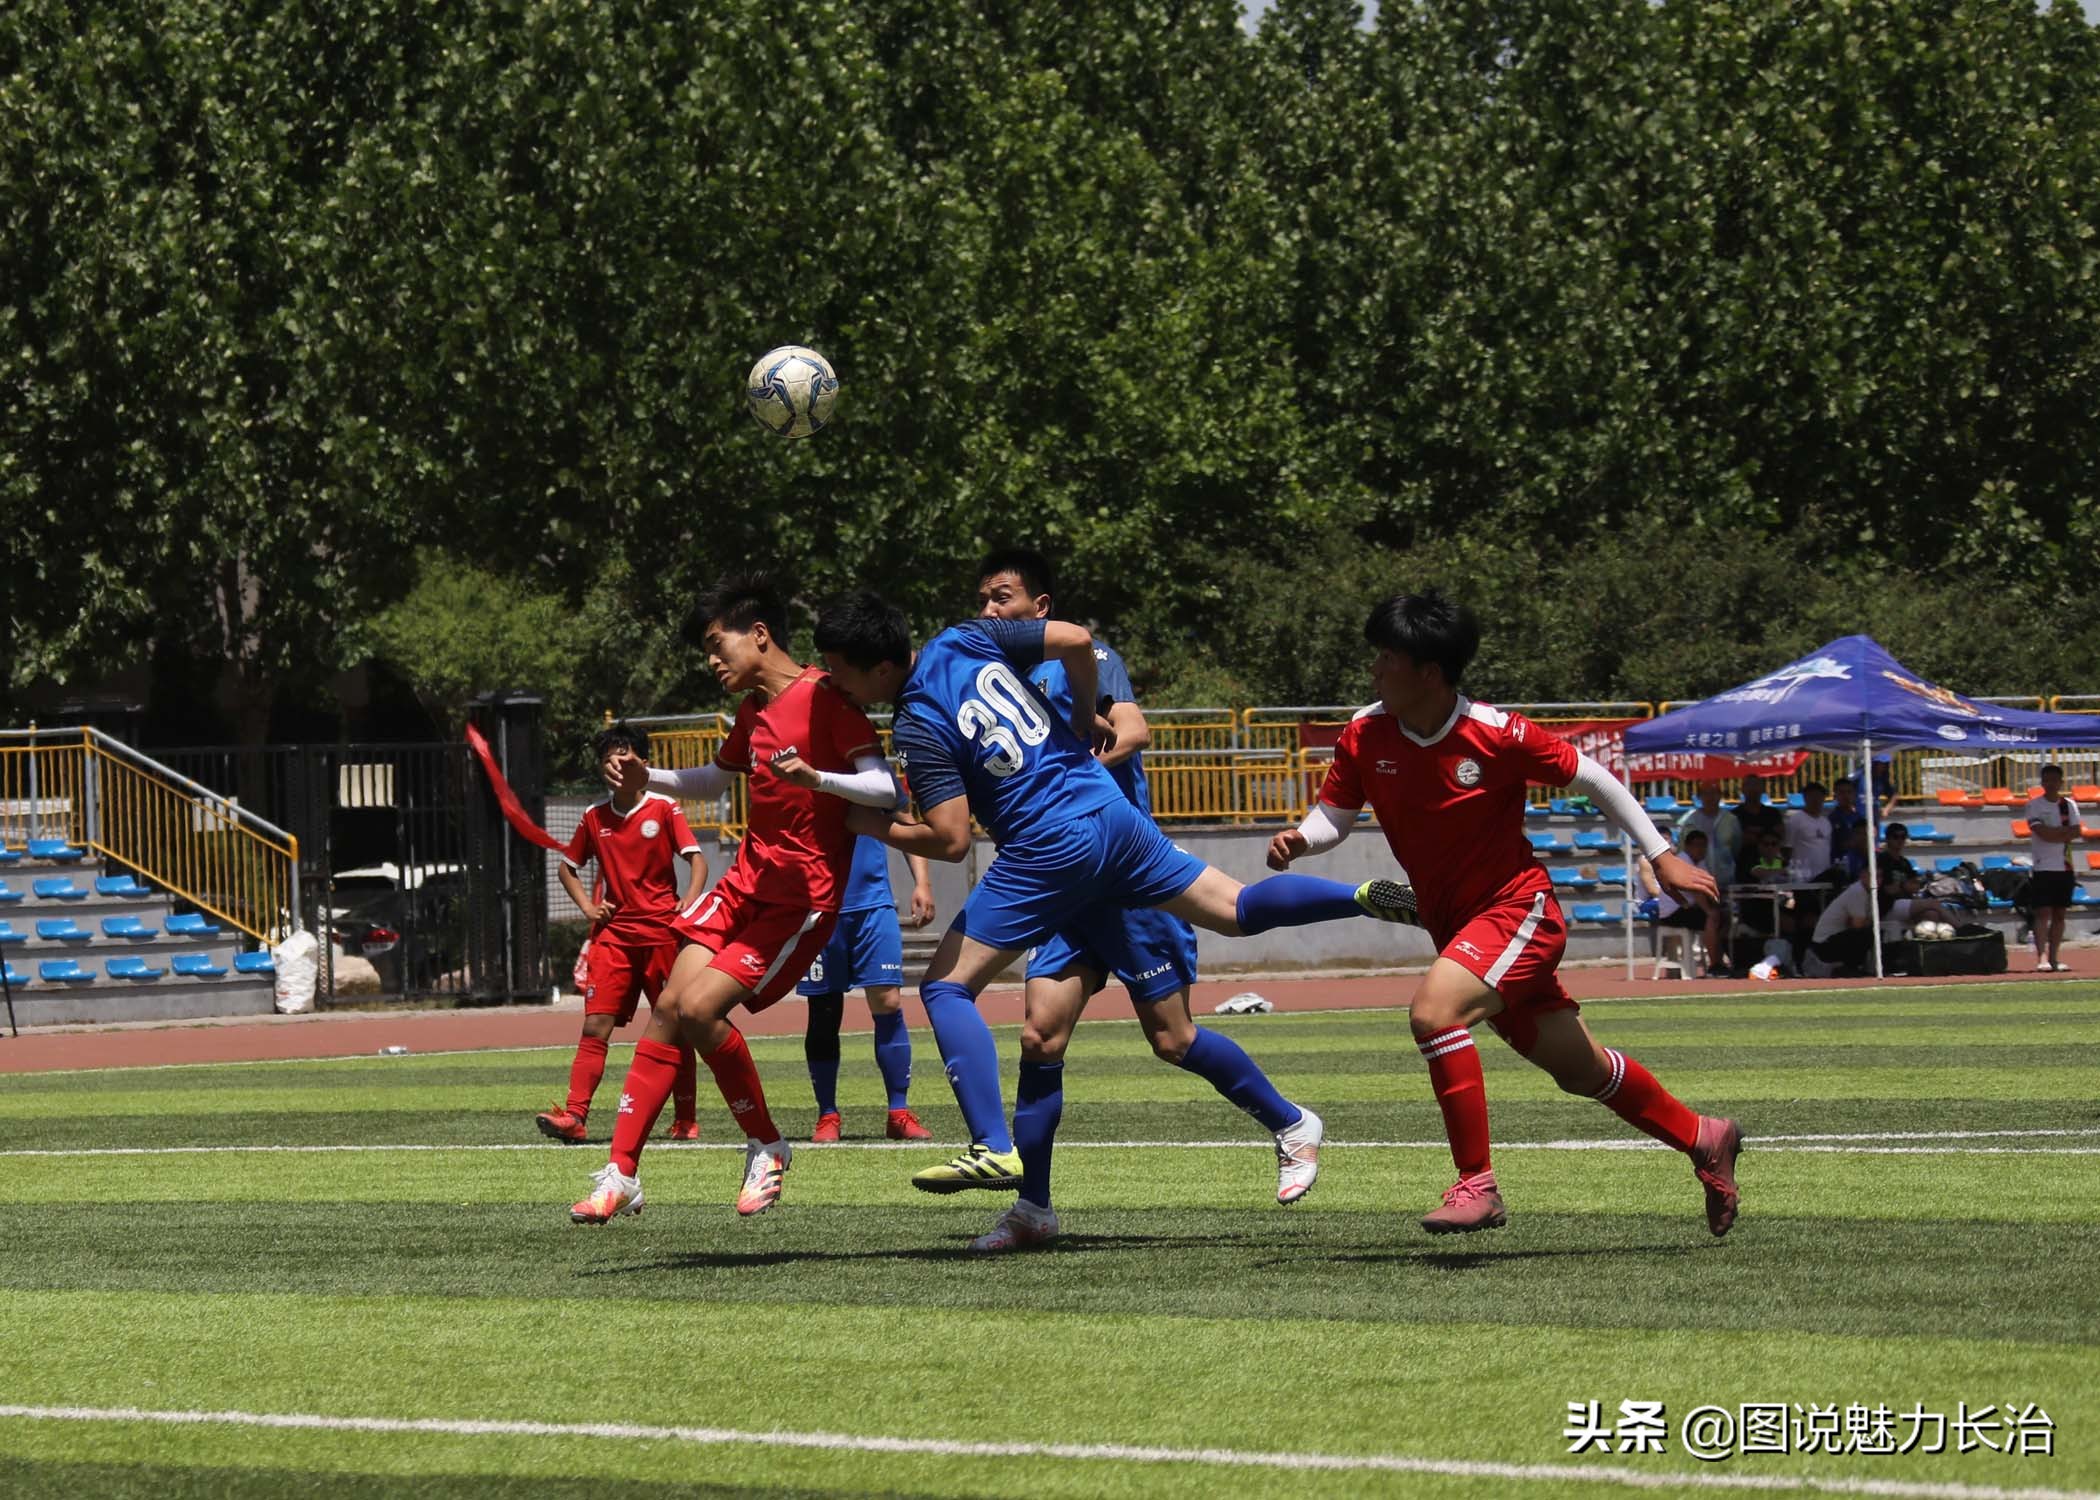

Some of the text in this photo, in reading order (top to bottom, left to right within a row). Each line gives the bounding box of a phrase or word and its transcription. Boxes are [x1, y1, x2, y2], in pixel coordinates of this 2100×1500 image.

[957, 661, 1052, 777] 30
[800, 954, 824, 982] 6
[1135, 961, 1173, 982] KELME
